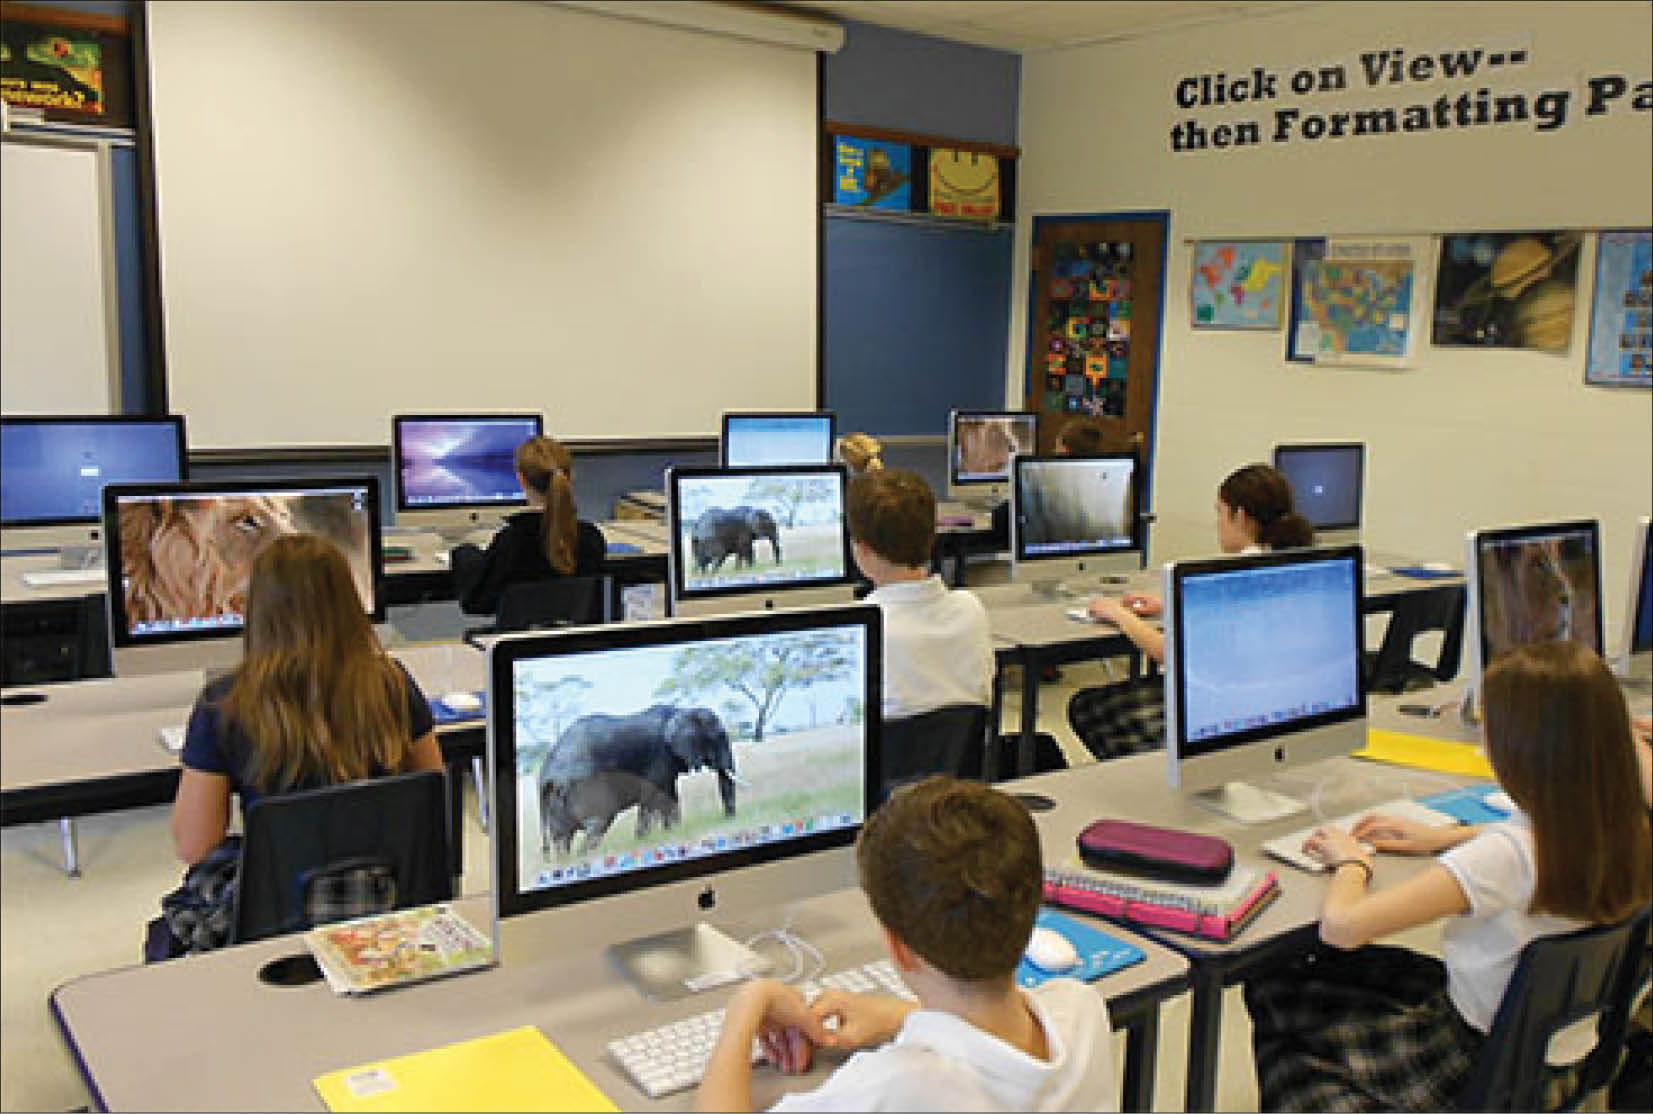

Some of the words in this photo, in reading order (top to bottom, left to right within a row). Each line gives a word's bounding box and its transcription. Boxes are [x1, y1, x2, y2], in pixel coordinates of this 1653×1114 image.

[1176, 67, 1277, 109] Click
[1291, 67, 1347, 95] on
[1170, 120, 1260, 153] then
[1272, 87, 1571, 143] Formatting
